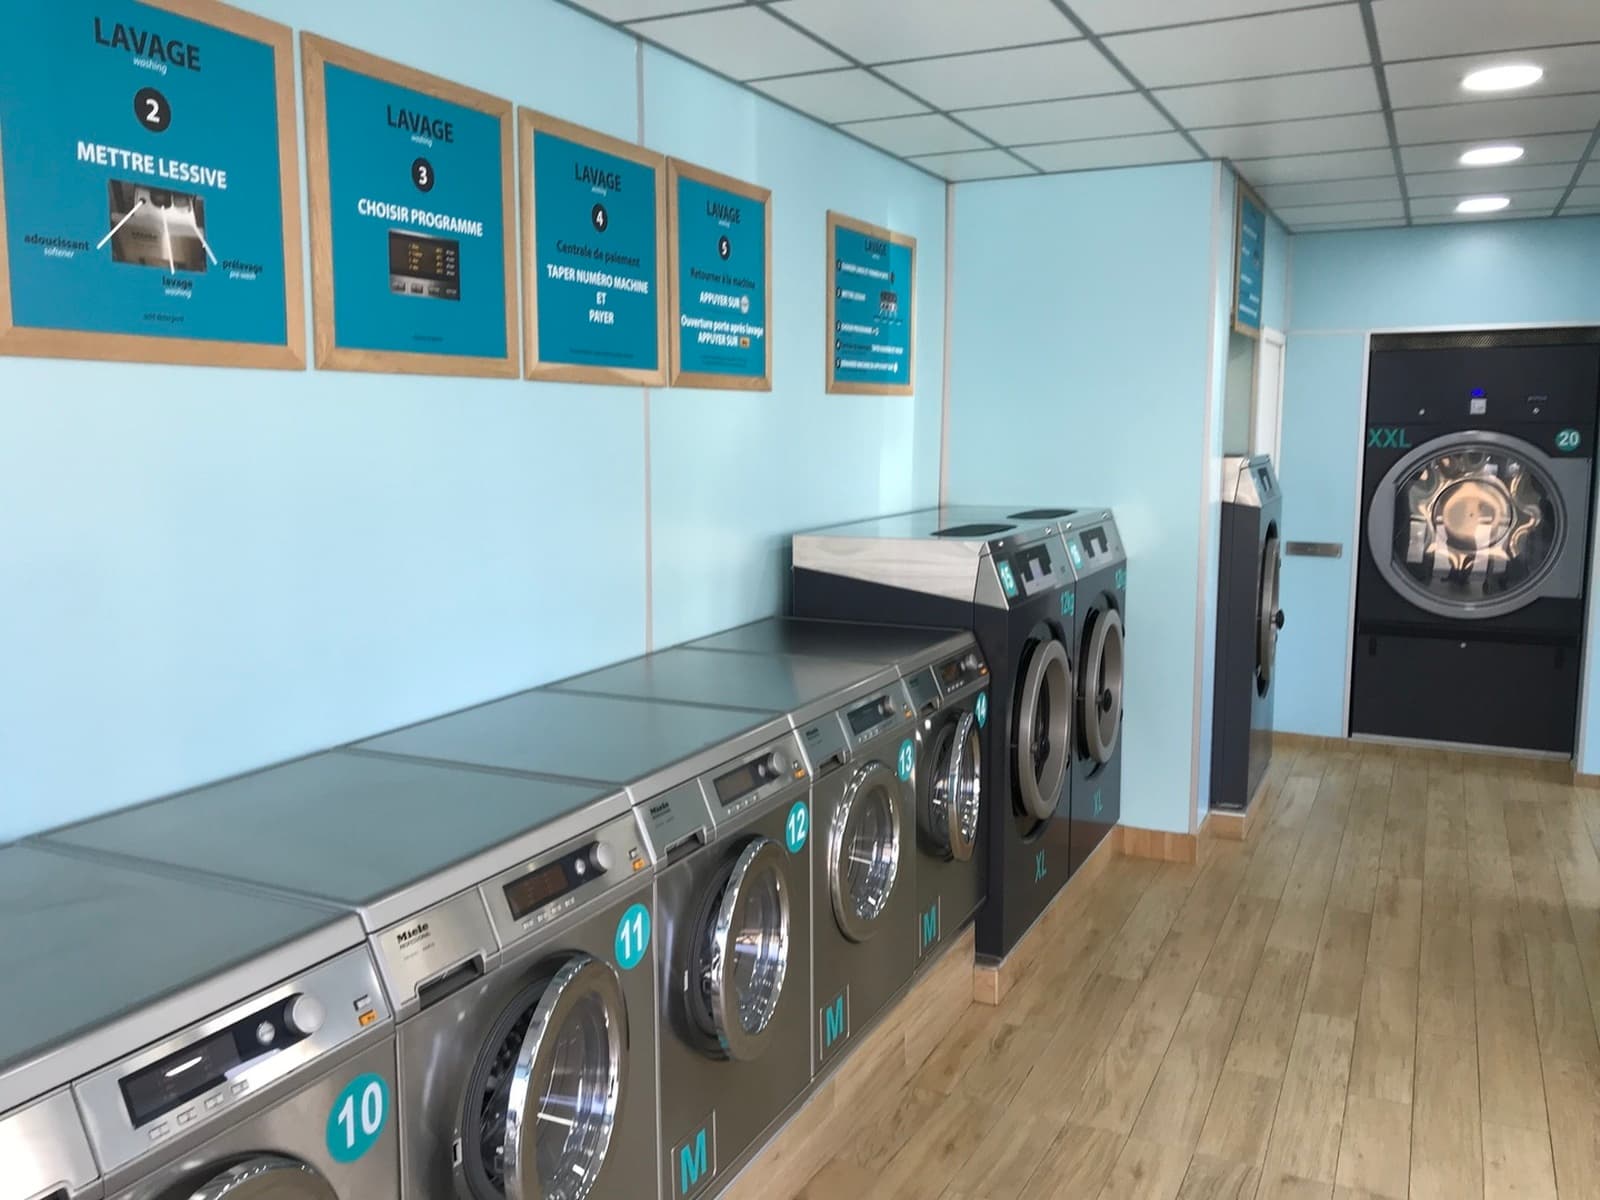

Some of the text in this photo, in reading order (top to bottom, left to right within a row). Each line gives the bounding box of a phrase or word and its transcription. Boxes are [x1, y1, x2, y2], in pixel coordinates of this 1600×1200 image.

[94, 17, 201, 72] LAVAGE
[133, 57, 168, 76] washing
[145, 98, 161, 123] 2
[387, 104, 454, 143] LAVAGE
[77, 141, 227, 190] METTRE LESSIVE
[418, 166, 428, 185] 3
[575, 163, 621, 192] LAVAGE
[357, 198, 484, 237] CHOISIR PROGRAMME
[596, 210, 604, 226] 4
[706, 200, 741, 224] LAVAGE
[24, 233, 90, 251] adoucissant
[556, 240, 640, 267] Centrale de paiement
[721, 240, 728, 256] 5
[162, 276, 193, 289] lavage
[546, 264, 649, 294] TAPER NUMÉRO MACHINE
[596, 291, 607, 305] ET
[699, 290, 740, 309] APPUYER SUR
[589, 309, 615, 325] PAYER
[680, 314, 713, 330] Ouverture
[697, 331, 738, 347] APPUYER SUR
[1368, 427, 1411, 449] XXL
[1557, 430, 1580, 447] 20
[976, 696, 987, 722] 14
[899, 743, 913, 776] 13
[1094, 787, 1104, 817] XL
[789, 809, 806, 845] 12
[1035, 849, 1047, 883] XL
[397, 923, 429, 944] Miele
[620, 911, 643, 960] 11
[922, 904, 936, 948] M
[825, 995, 844, 1048] M
[337, 1080, 383, 1149] 10
[680, 1127, 707, 1195] M
